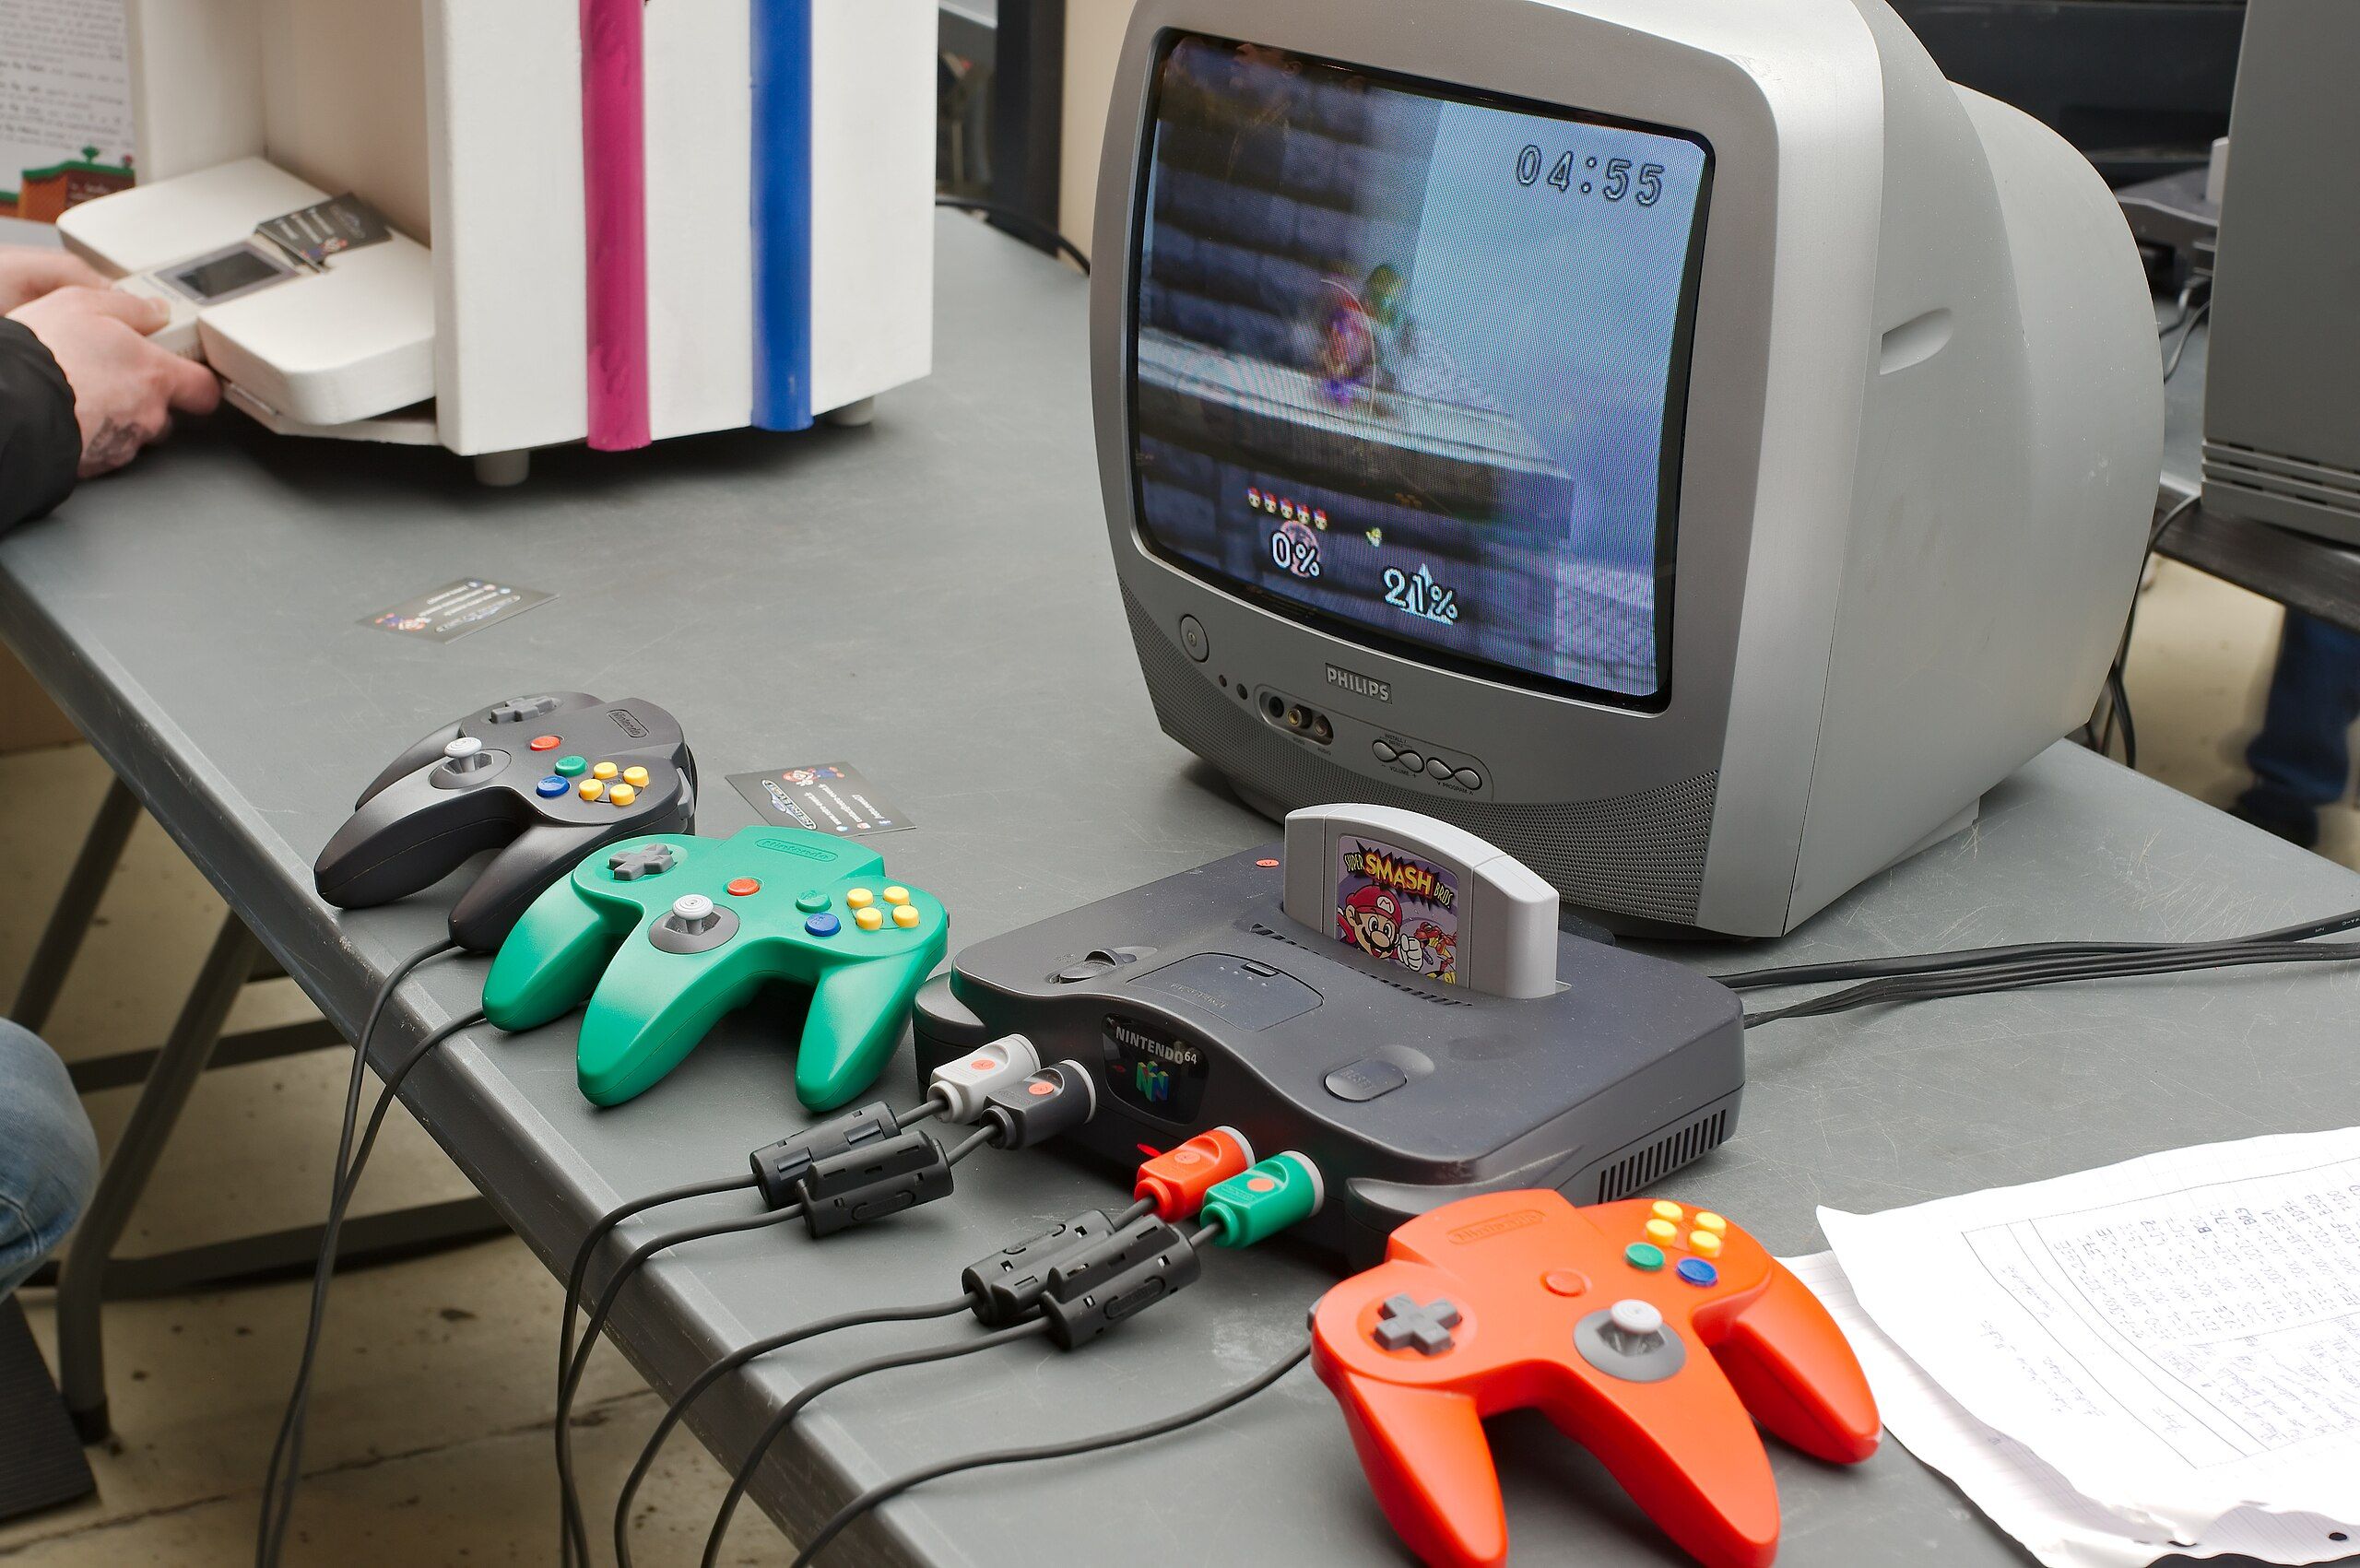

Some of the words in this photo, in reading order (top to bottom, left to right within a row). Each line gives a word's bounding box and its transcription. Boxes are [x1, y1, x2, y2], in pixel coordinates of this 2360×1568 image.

[1516, 144, 1665, 207] 04:55
[1271, 531, 1321, 578] 0%
[1383, 567, 1458, 619] 21%
[1327, 666, 1389, 701] PHILIPS
[1344, 852, 1364, 872] SUPER
[1365, 854, 1433, 896] SMASH
[1434, 882, 1454, 909] BROS.
[1115, 1026, 1185, 1065] NINTENDO
